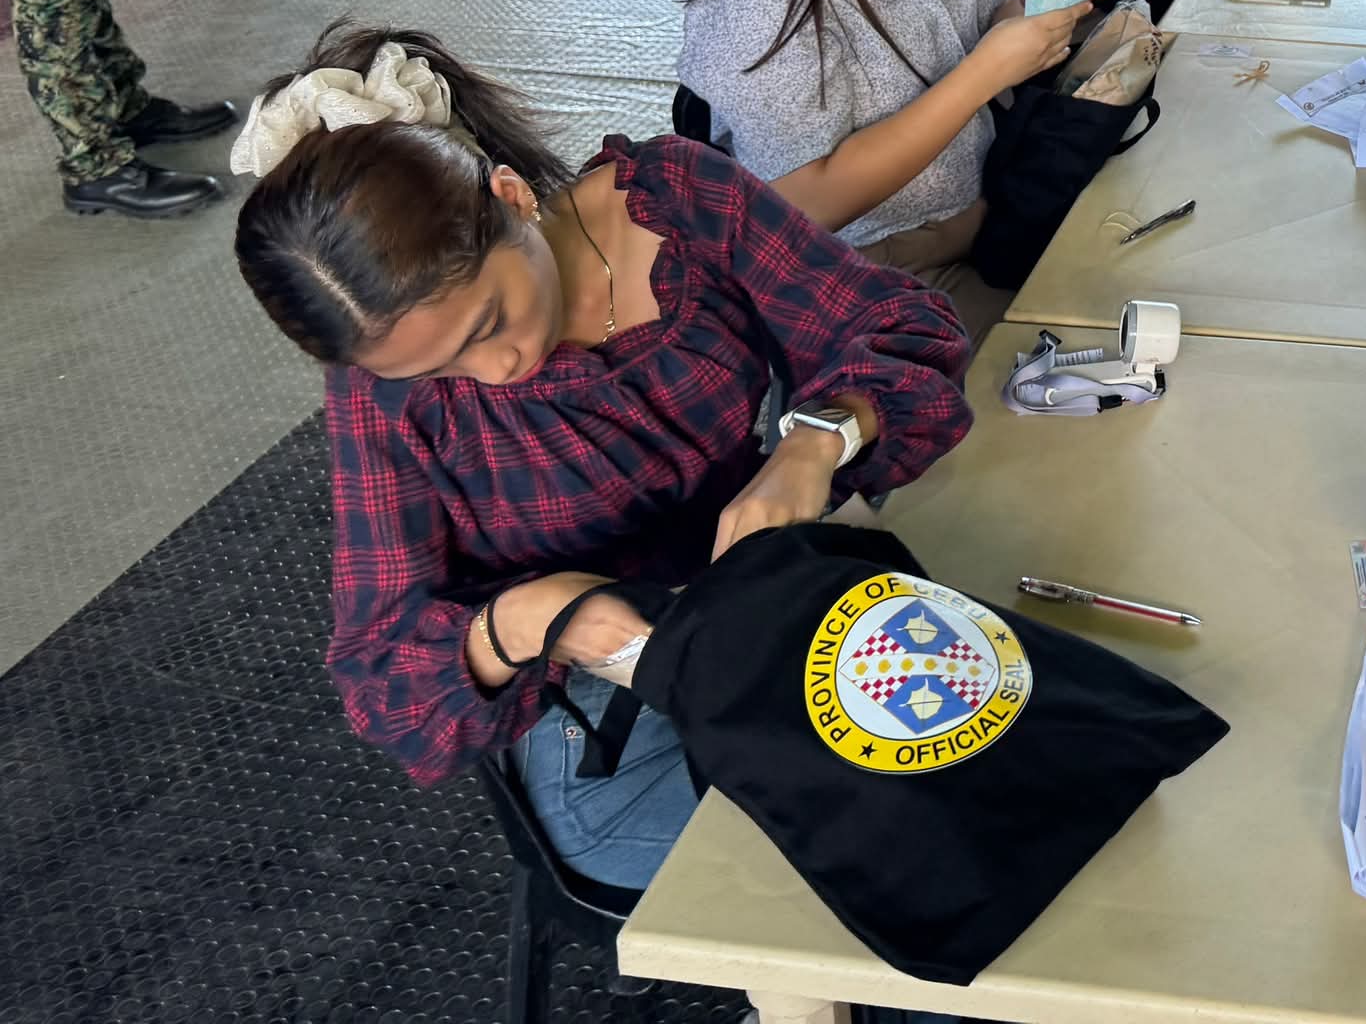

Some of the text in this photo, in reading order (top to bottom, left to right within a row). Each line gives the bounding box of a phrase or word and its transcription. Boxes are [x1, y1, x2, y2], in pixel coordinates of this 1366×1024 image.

[811, 577, 988, 744] PROVINCE OF CEBU
[895, 658, 1023, 766] OFFICIAL SEAL
